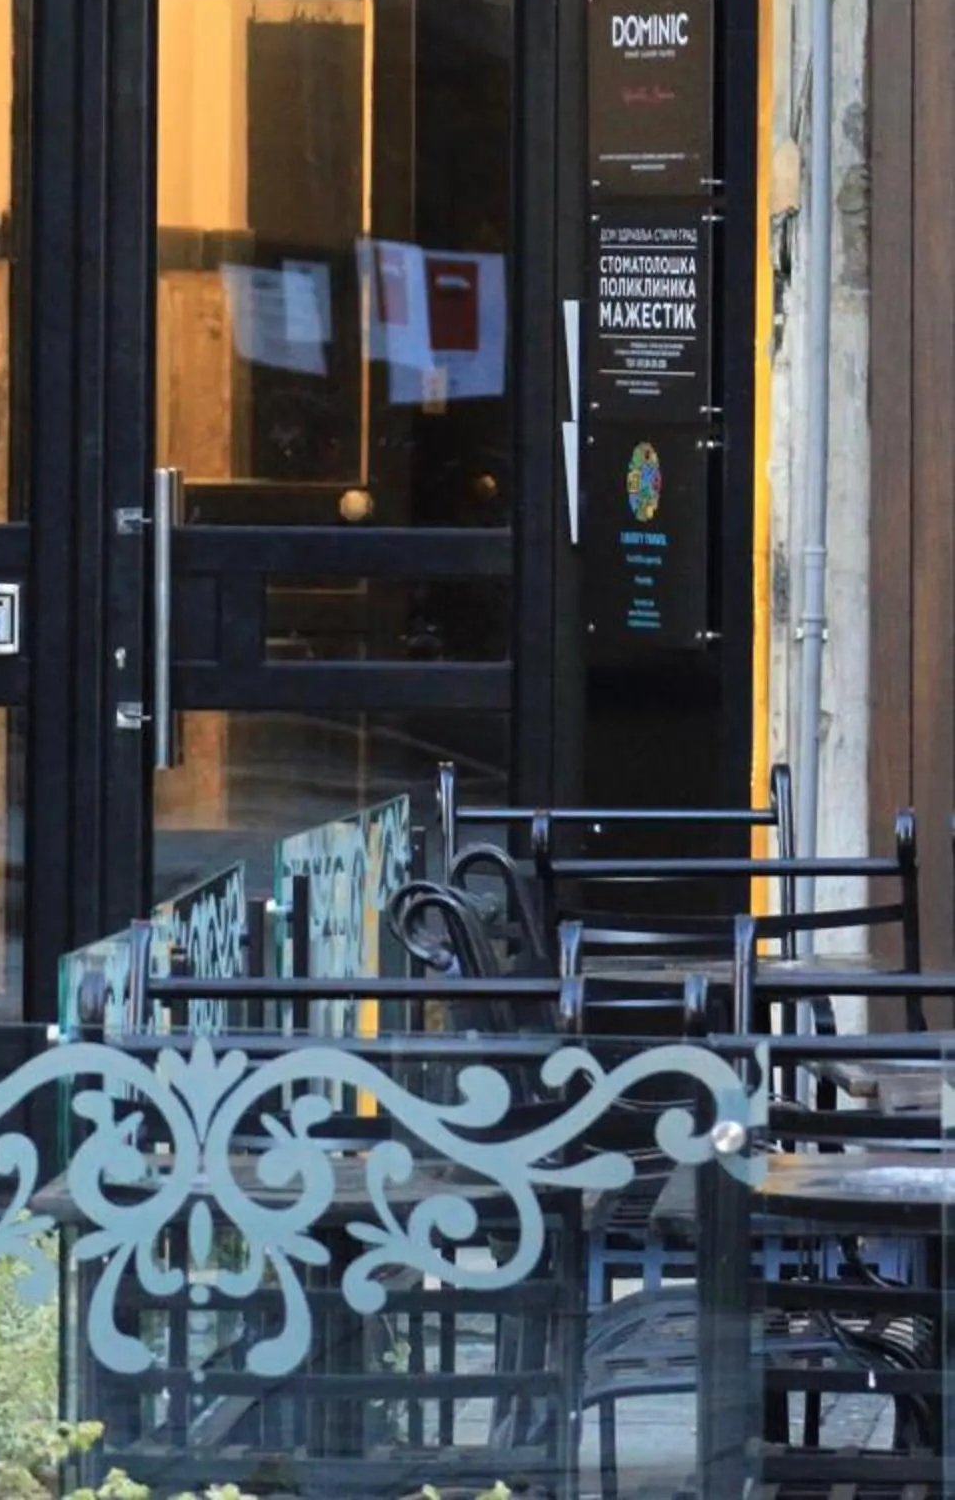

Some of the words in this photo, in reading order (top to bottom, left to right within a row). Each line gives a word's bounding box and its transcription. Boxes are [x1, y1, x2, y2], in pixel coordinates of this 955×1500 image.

[611, 12, 689, 48] DOMINIC
[599, 255, 696, 274] СТОМАТОЛОШКА
[599, 277, 696, 298] ПОЛИКЛИНИКА
[599, 301, 696, 329] МАЖЕСТИК
